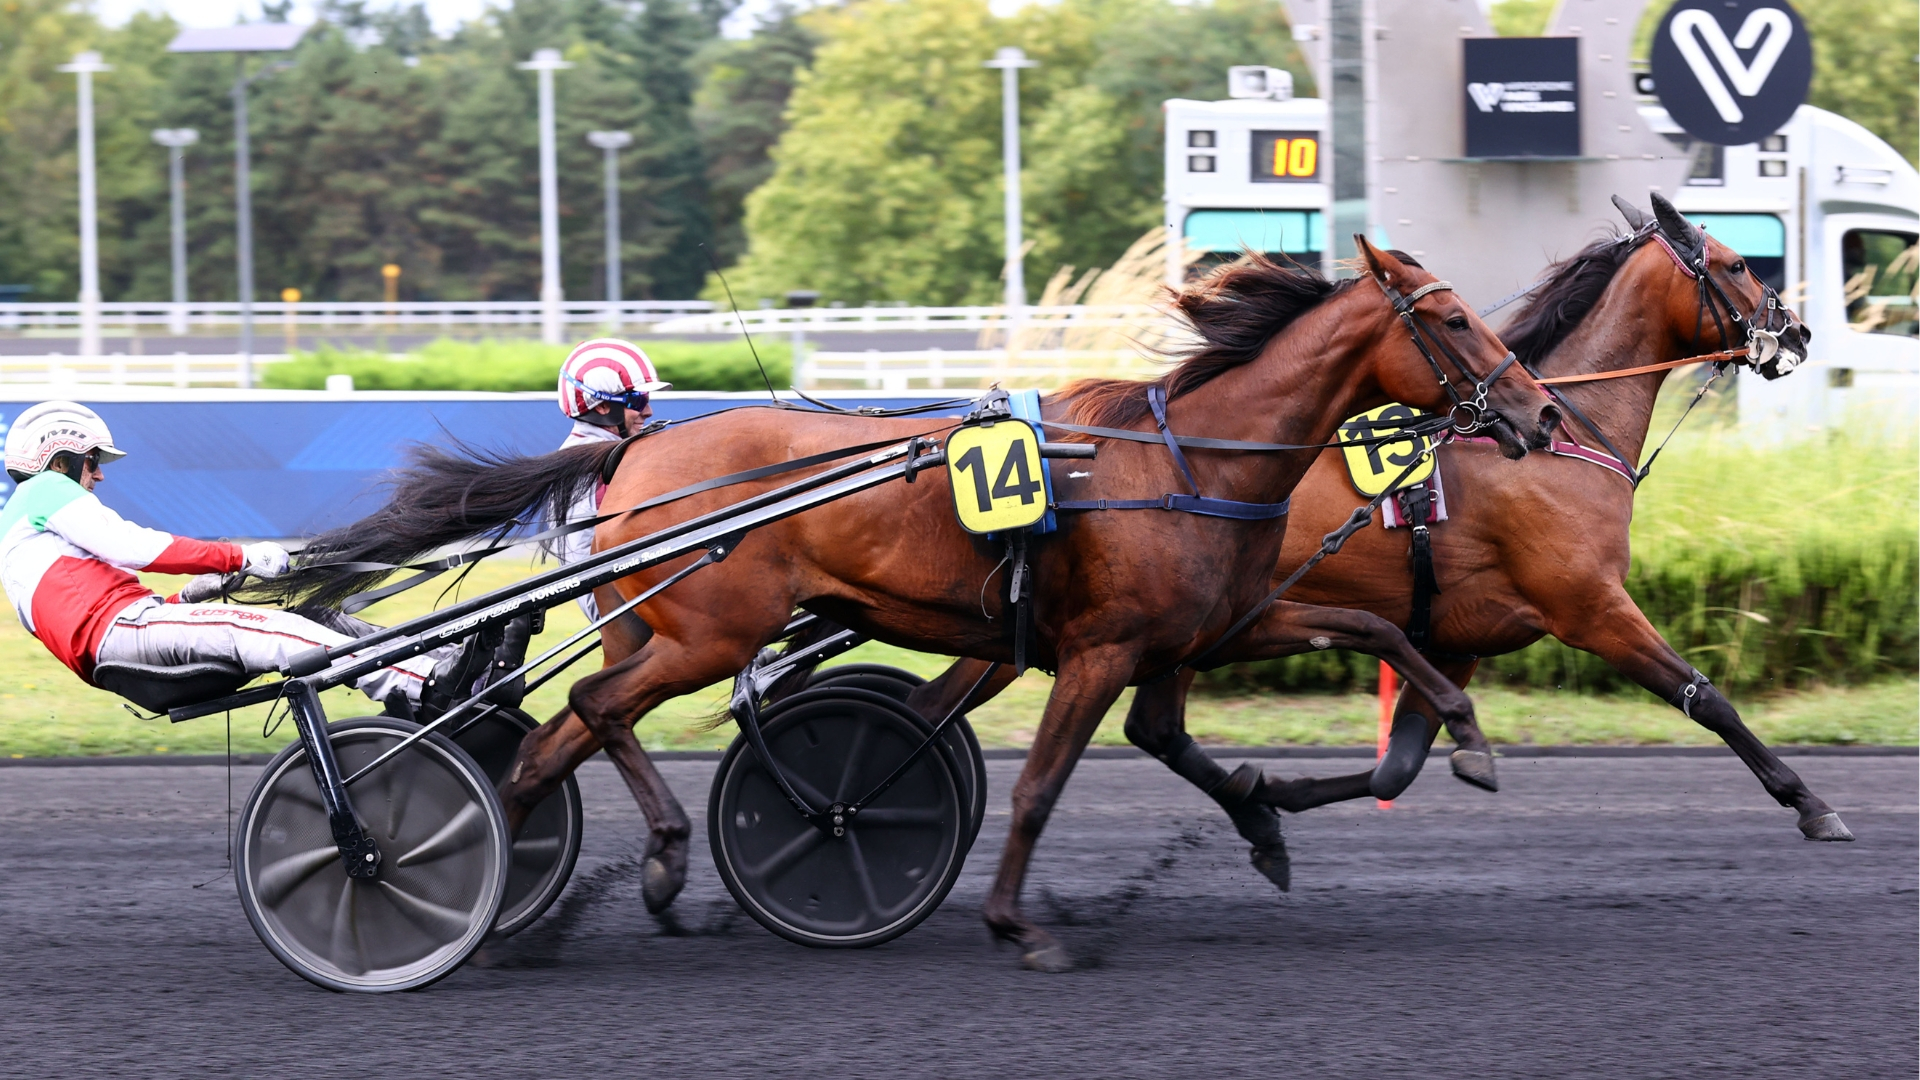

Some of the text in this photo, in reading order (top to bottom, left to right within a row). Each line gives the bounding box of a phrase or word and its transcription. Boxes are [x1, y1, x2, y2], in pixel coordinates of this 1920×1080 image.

[1272, 137, 1319, 177] 10
[1345, 405, 1425, 475] 13
[954, 438, 1041, 513] 14
[527, 576, 581, 603] YONKERS
